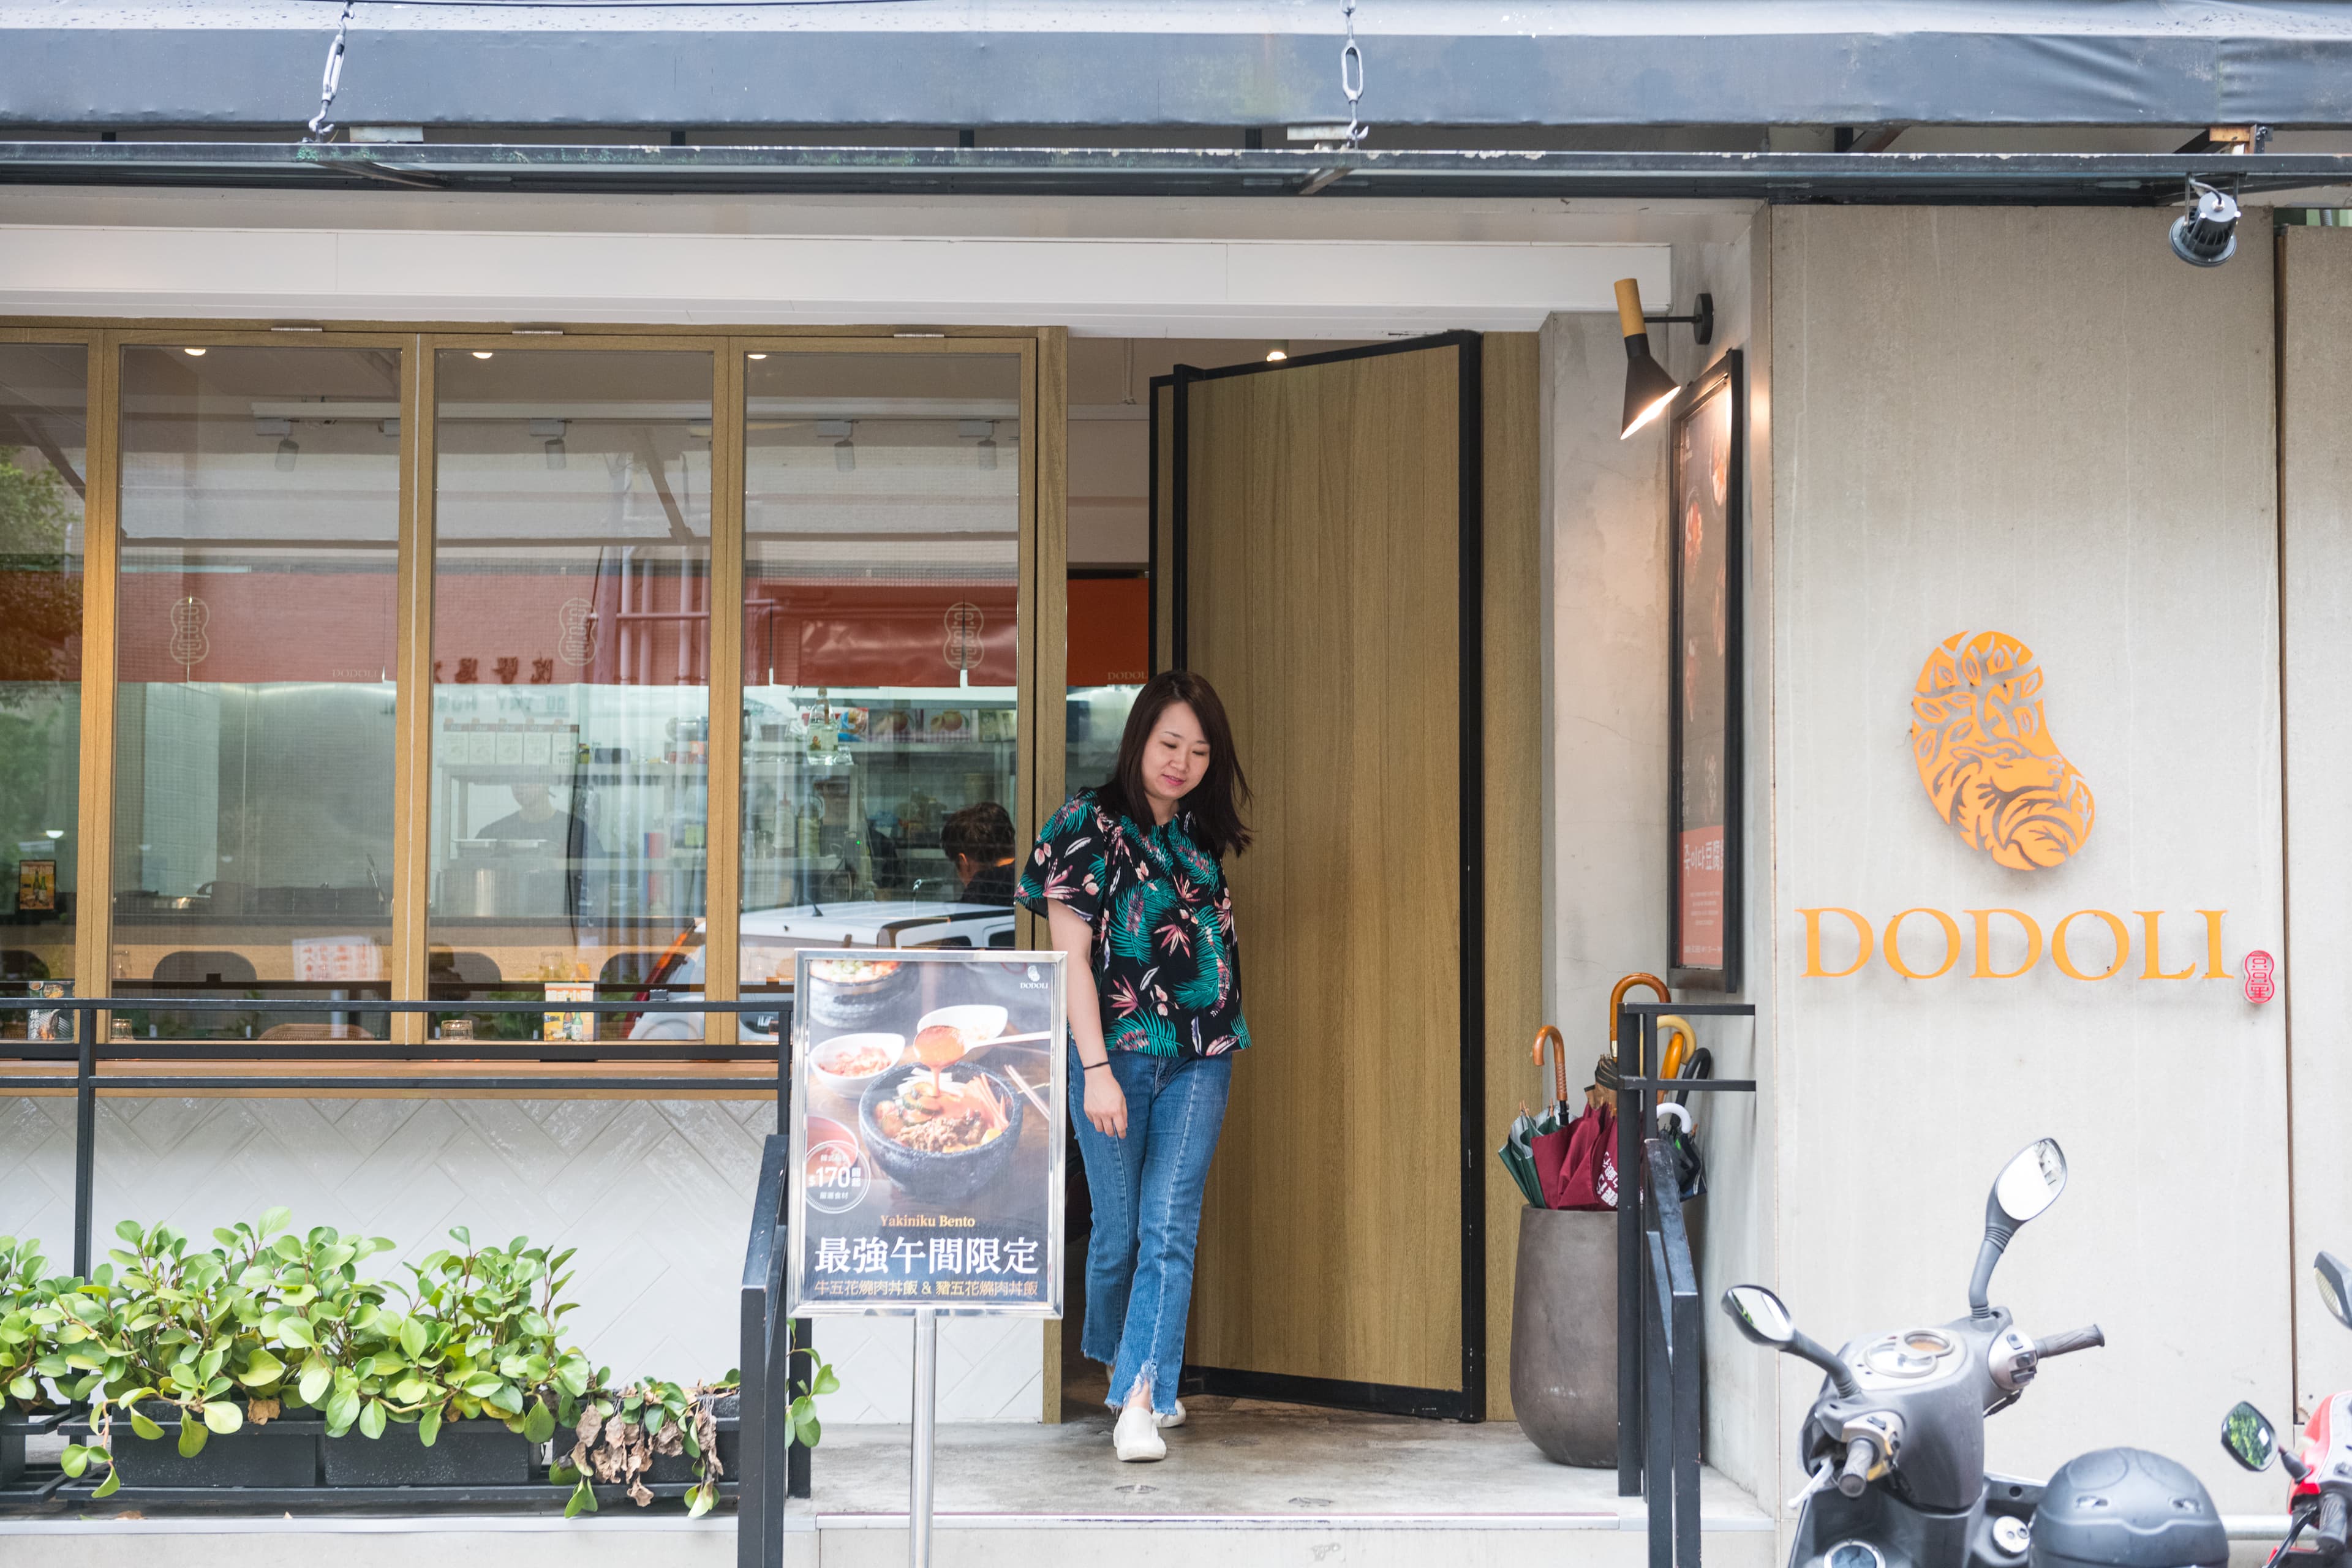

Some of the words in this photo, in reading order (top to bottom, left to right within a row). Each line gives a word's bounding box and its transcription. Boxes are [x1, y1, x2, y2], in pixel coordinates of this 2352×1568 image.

[1107, 671, 1147, 680] DODOL
[1794, 907, 2234, 981] DODOLI
[880, 1215, 936, 1227] Yakiniku
[939, 1215, 976, 1227] Bento
[814, 1236, 1039, 1275] 最強午間限定
[814, 1280, 918, 1297] 牛五花燒肉丼飯
[921, 1282, 932, 1295] &
[935, 1280, 1038, 1297] 豬五花燒肉丼飯
